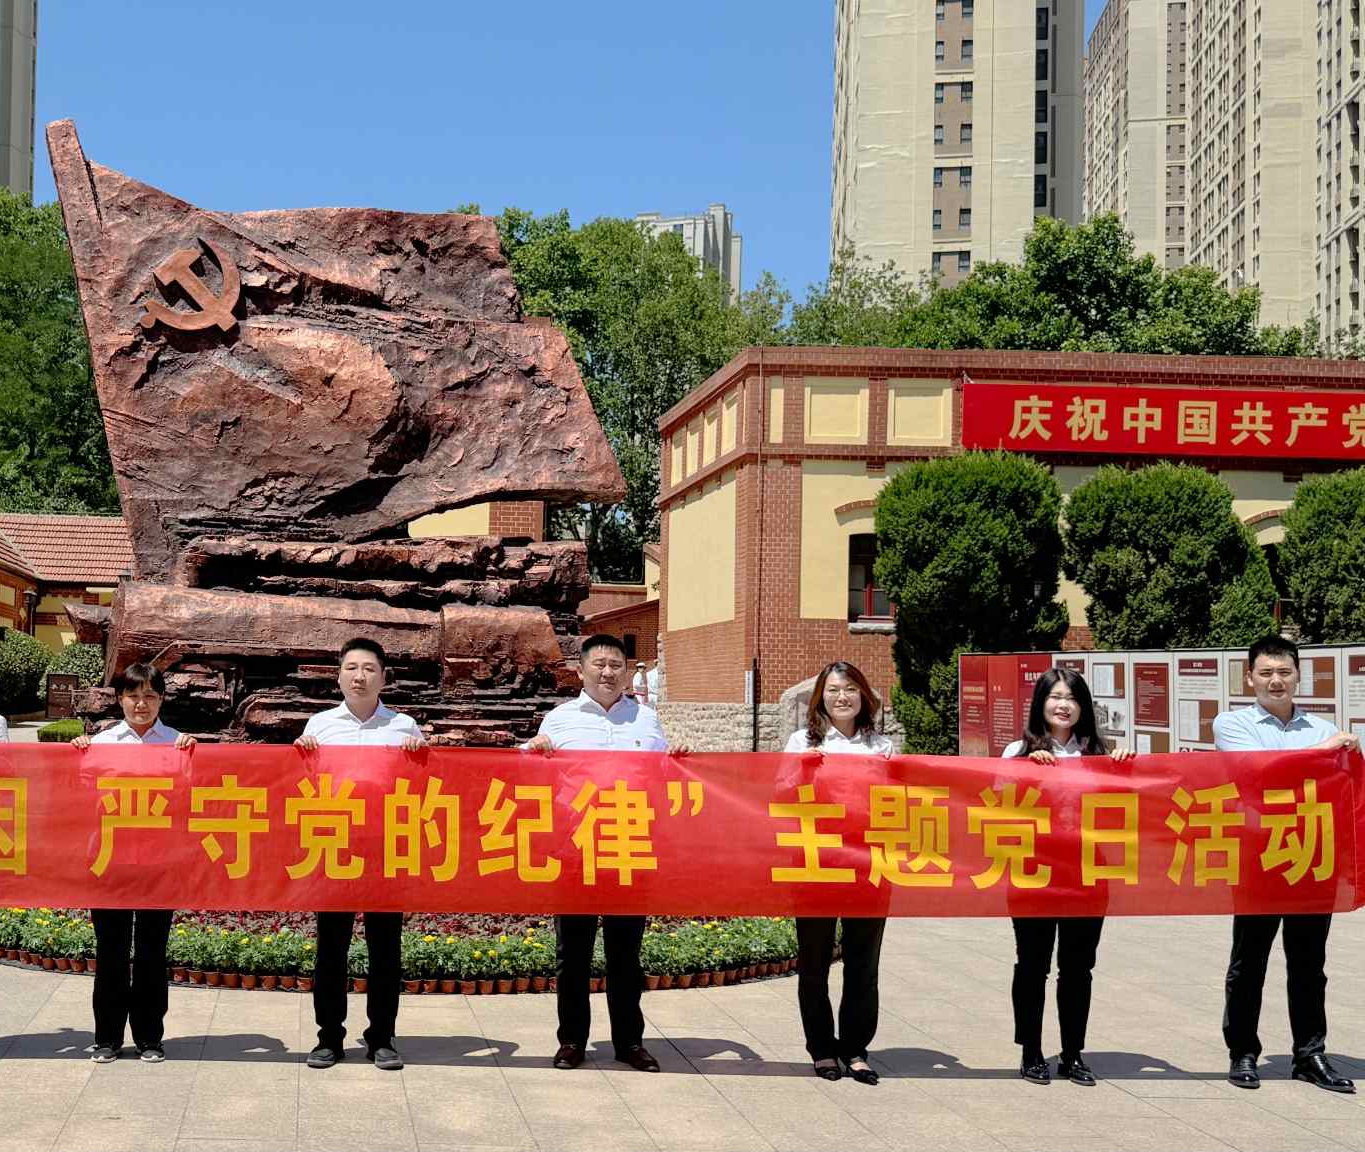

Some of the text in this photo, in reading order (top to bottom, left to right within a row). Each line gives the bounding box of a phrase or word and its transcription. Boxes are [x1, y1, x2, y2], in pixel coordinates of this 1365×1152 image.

[1008, 394, 1365, 448] 庆祝中国共产党
[769, 778, 1336, 889] 主题党日活动
